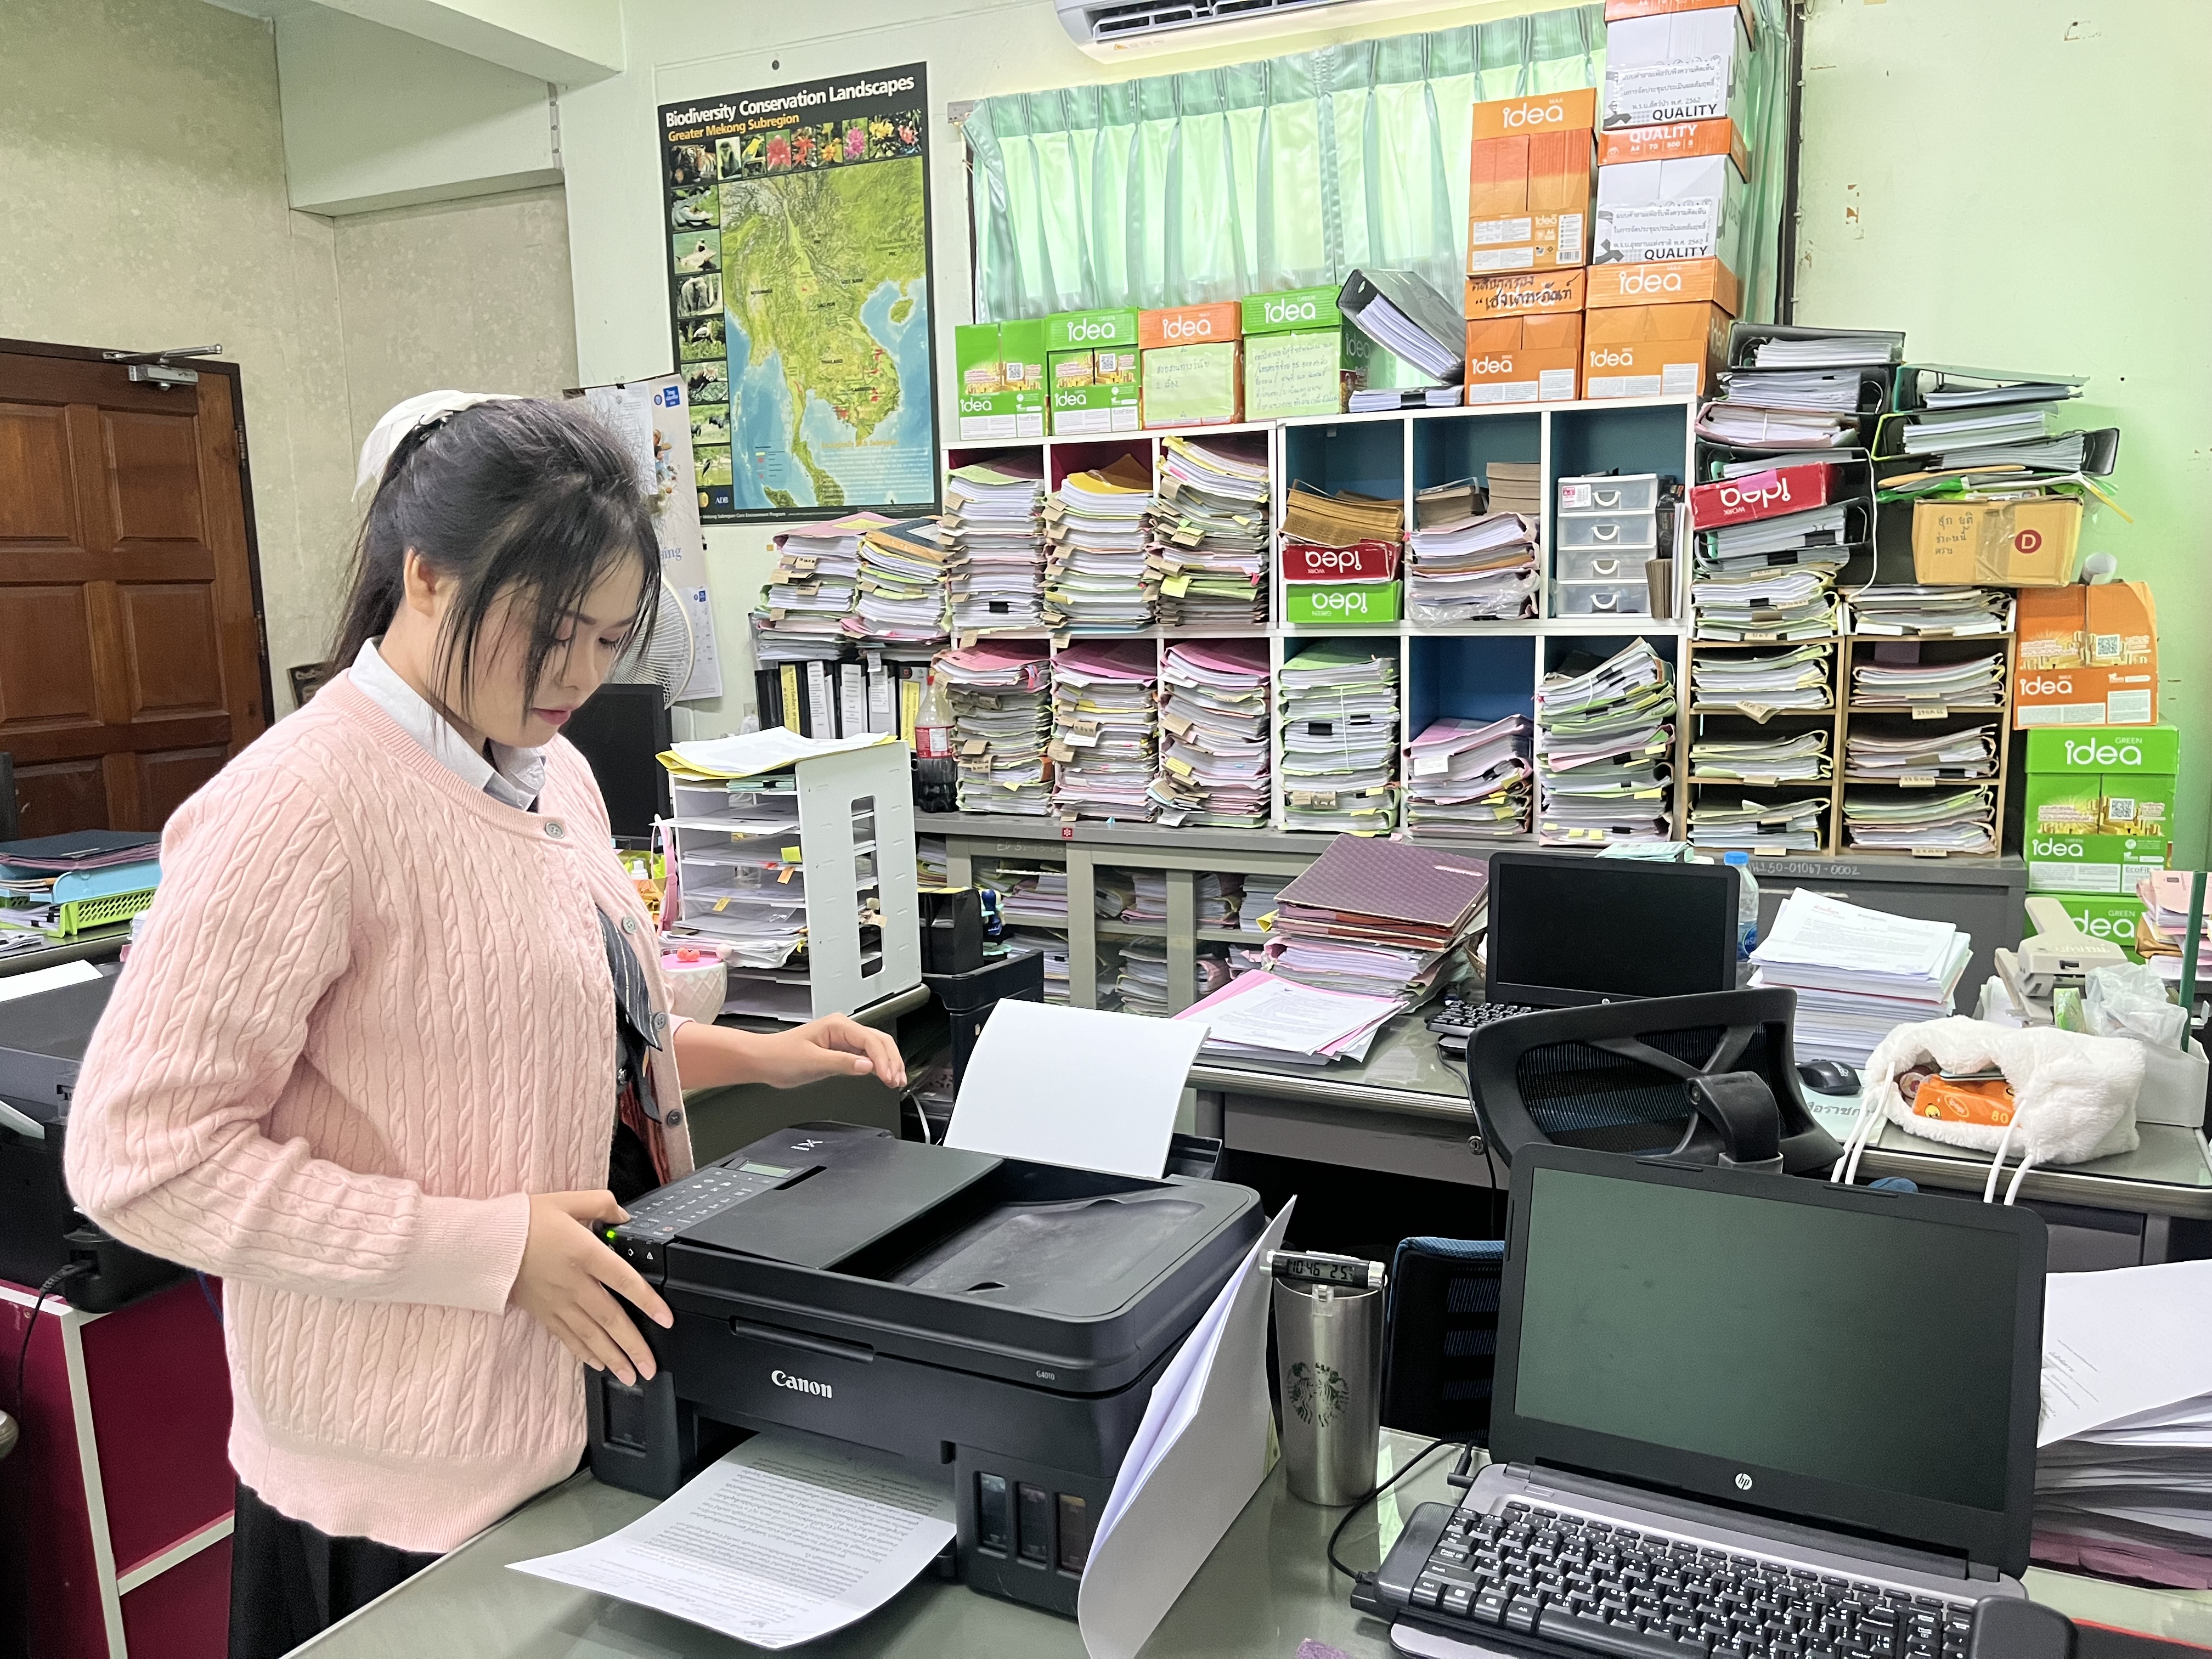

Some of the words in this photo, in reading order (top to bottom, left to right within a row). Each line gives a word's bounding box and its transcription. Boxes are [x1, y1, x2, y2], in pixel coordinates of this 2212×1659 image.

[1623, 77, 1714, 95] นการจัดประชุมประเมินผลสัมฤทธิ์
[666, 104, 736, 127] Biodiversity
[740, 90, 826, 116] Conservation
[829, 76, 915, 101] Landscapes
[1502, 102, 1562, 128] idea
[1652, 104, 1718, 121] QUALITY
[668, 128, 703, 142] Greater
[706, 121, 746, 137] Mekong
[748, 113, 799, 131] Subregion
[1629, 125, 1697, 143] QUALITY
[1644, 246, 1708, 261] QUALITY
[1618, 267, 1681, 295] idea
[1264, 298, 1316, 323] idea
[1067, 318, 1115, 342] idea
[1162, 315, 1211, 339] idea
[1472, 356, 1513, 374] idea
[1590, 351, 1633, 368] idea
[960, 397, 992, 413] idea
[1054, 391, 1087, 407] idea
[1723, 506, 1746, 516] WORK
[2021, 533, 2037, 550] D
[1305, 550, 1363, 573] idea
[1312, 592, 1368, 616] idea
[2019, 675, 2072, 696] idea
[2064, 737, 2141, 765] idea
[2032, 838, 2083, 857] idea
[2072, 910, 2135, 938] dea
[1991, 1110, 2009, 1124] 80
[771, 1370, 832, 1399] Canon
[1036, 1370, 1055, 1380] G4010
